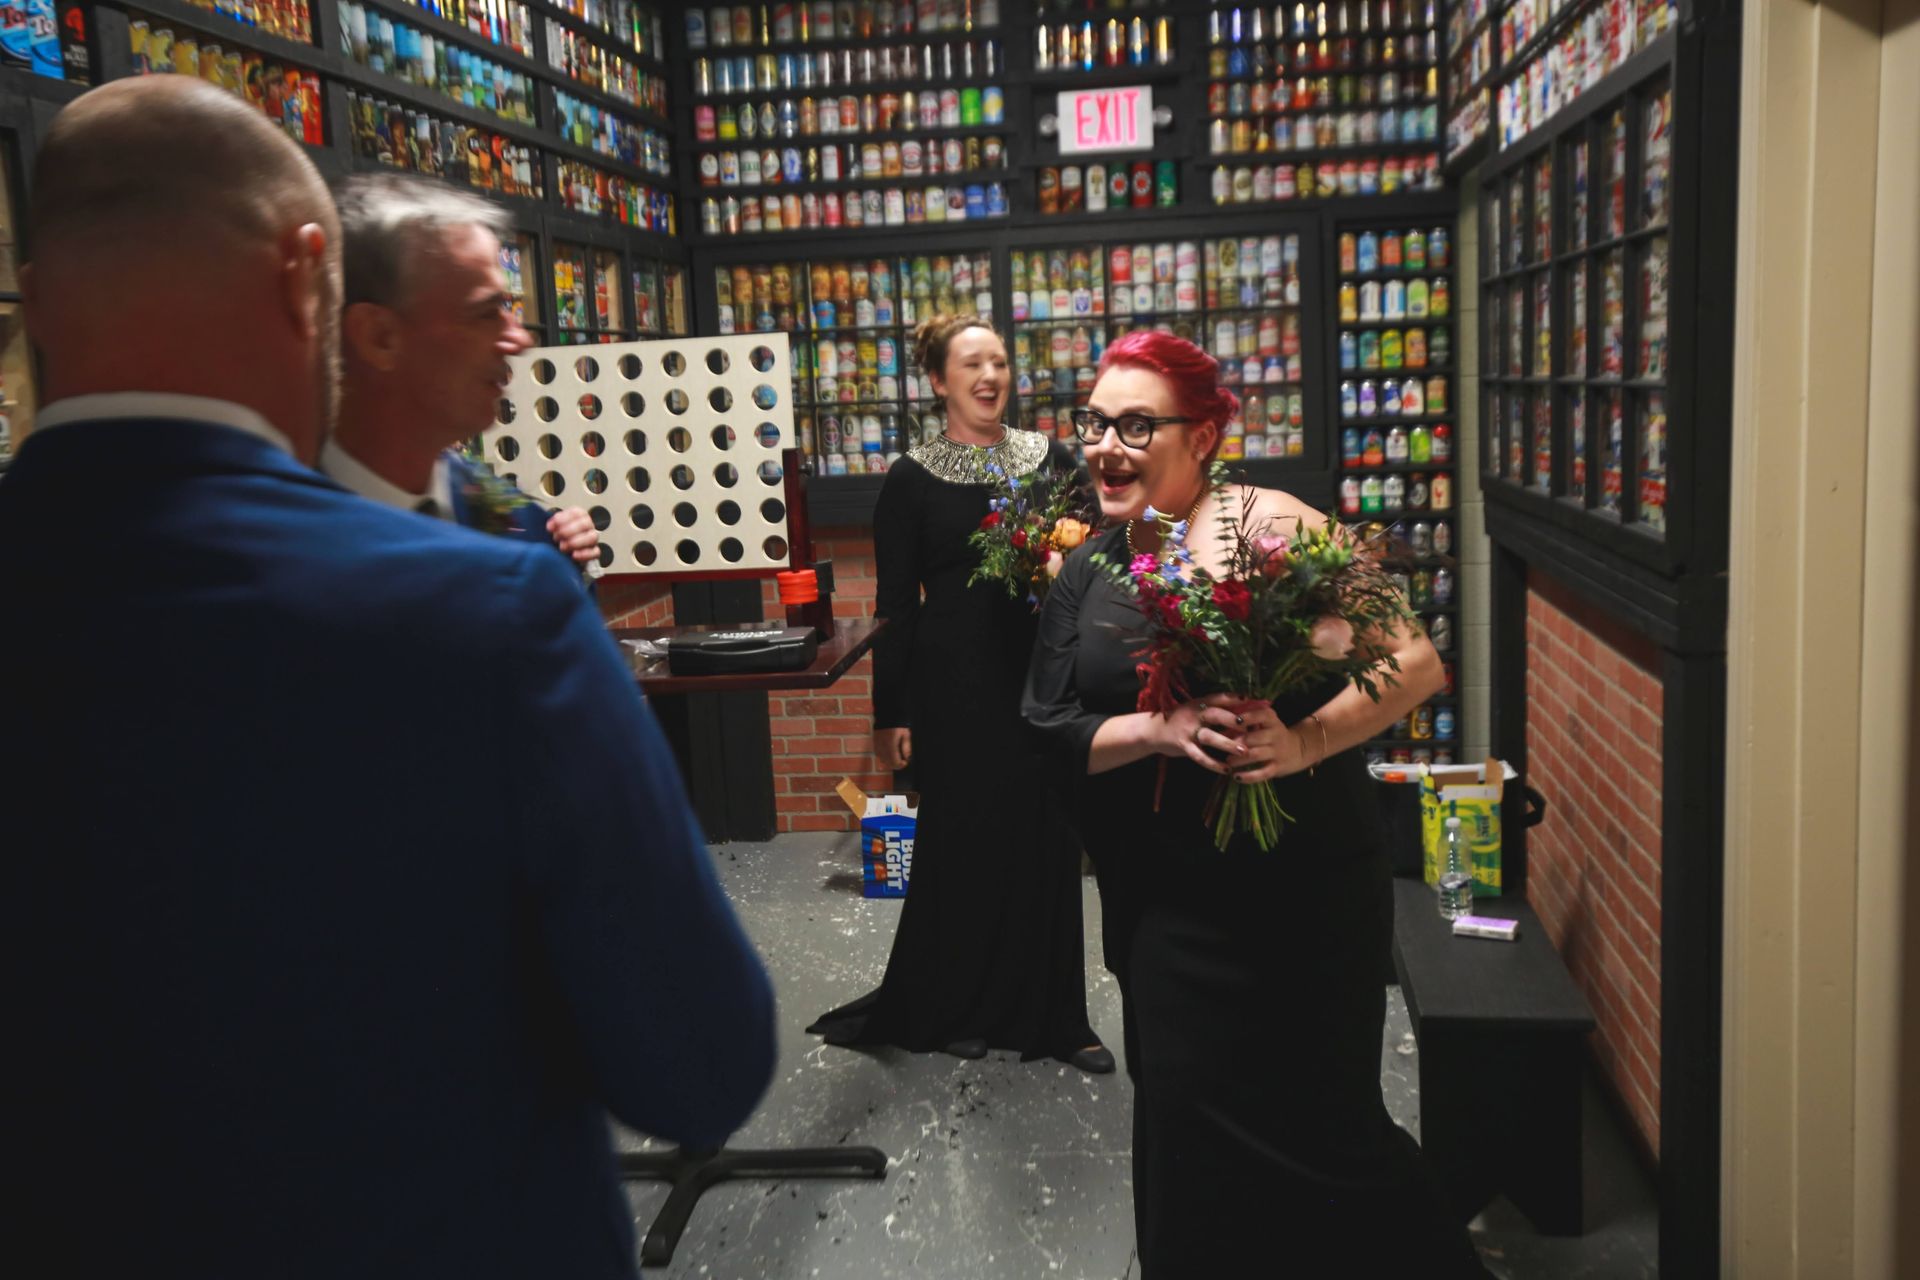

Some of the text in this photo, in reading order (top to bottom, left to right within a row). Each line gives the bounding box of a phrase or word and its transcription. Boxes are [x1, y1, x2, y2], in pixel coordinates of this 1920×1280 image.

[1074, 89, 1140, 146] EXIT
[884, 831, 903, 890] LIGHT
[901, 838, 914, 882] BUD
